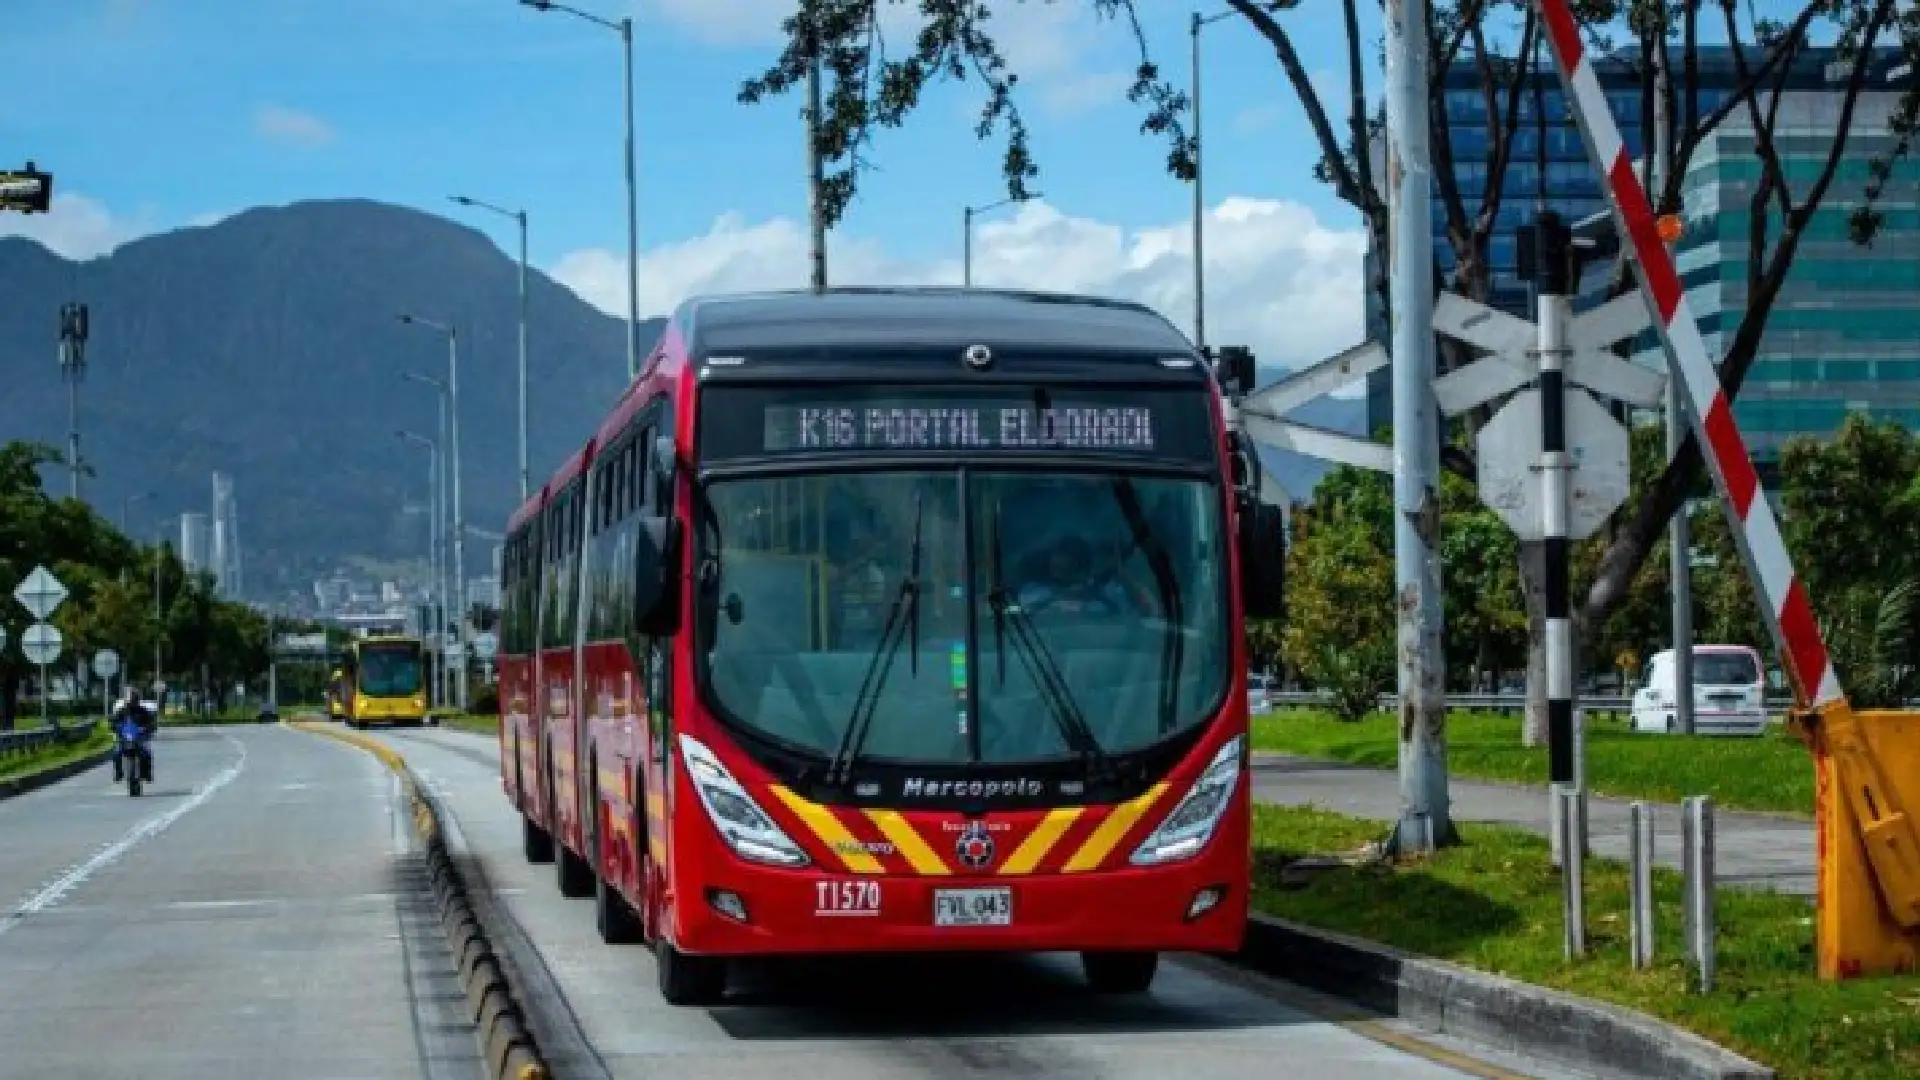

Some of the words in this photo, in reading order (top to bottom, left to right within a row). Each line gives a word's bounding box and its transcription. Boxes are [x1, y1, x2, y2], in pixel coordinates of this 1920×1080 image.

[801, 408, 856, 447] K16
[864, 408, 991, 447] PORTAL
[815, 881, 880, 910] T1570
